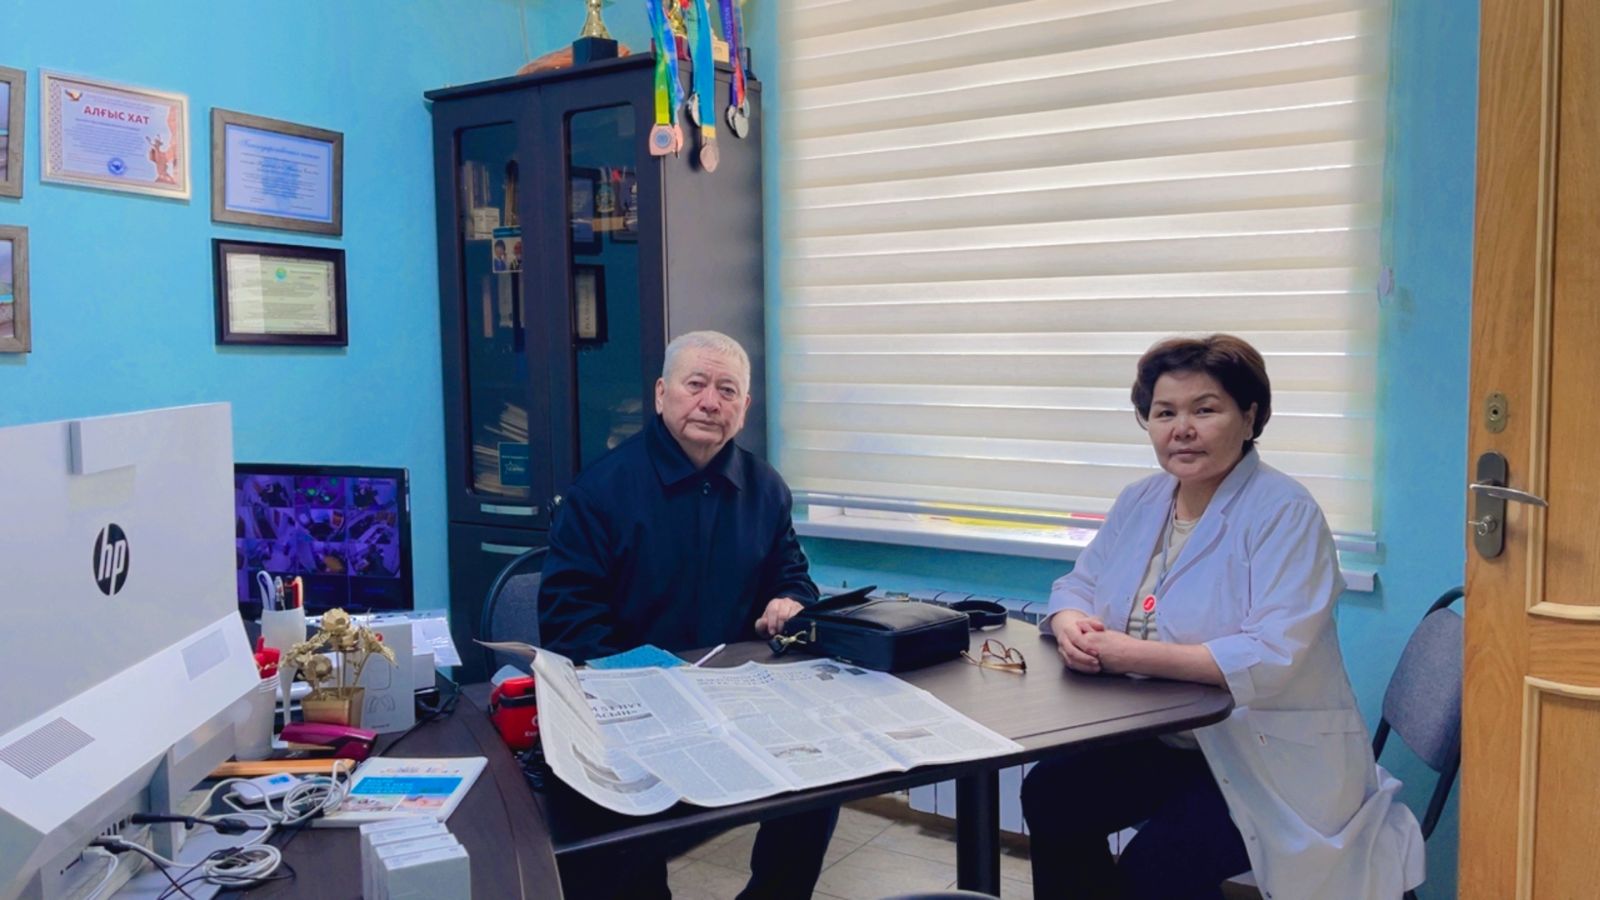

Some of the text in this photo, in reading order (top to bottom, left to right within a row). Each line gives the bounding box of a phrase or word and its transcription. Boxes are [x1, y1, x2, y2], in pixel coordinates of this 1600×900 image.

[84, 105, 125, 121] АЛҒЫС
[128, 113, 150, 125] ХАТ
[98, 523, 126, 596] hp
